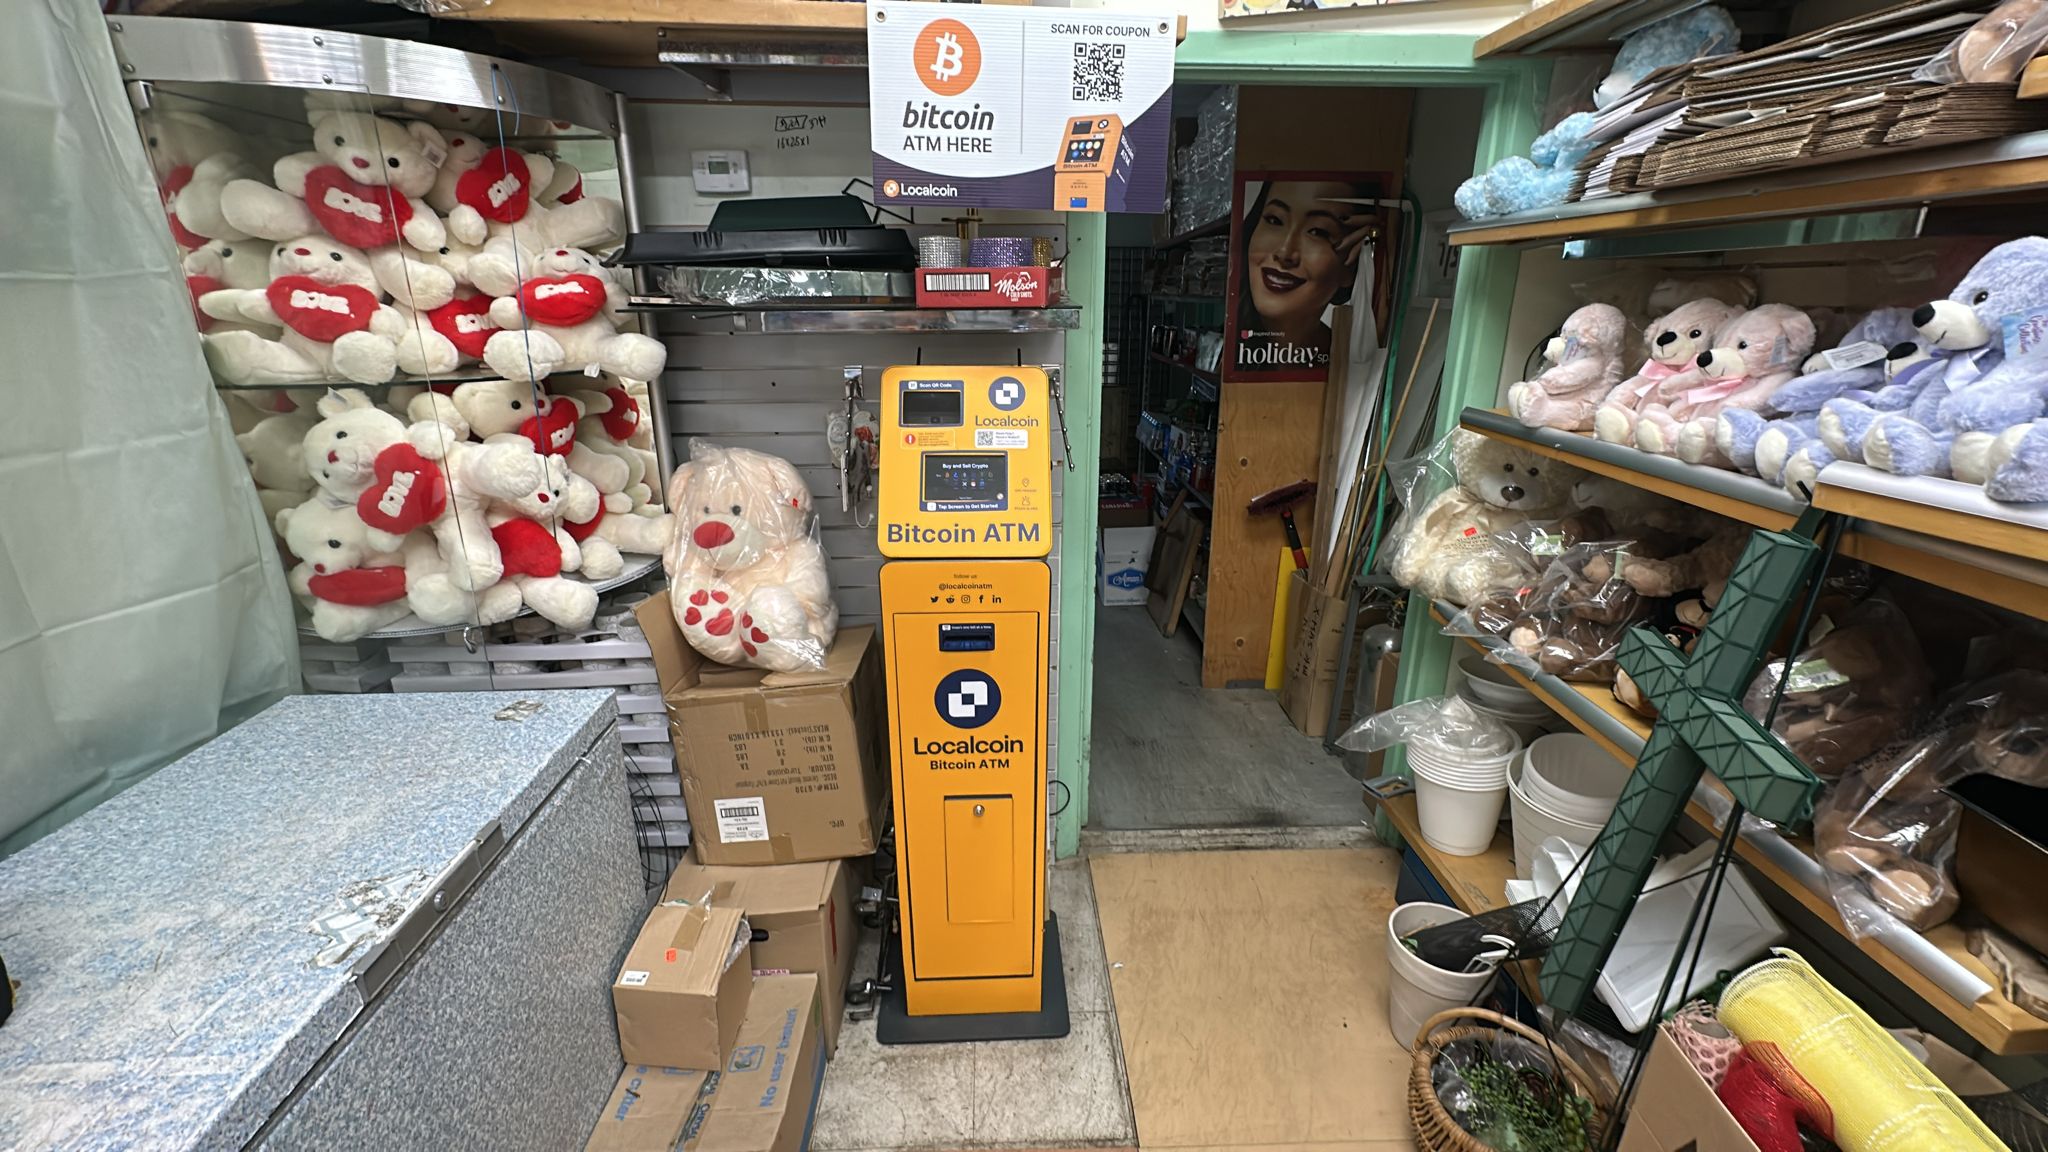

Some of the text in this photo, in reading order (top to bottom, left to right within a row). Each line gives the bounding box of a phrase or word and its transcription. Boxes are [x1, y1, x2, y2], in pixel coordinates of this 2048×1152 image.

[1051, 24, 1150, 38] SCAN FOR COUPON
[903, 101, 994, 131] bitcoin
[903, 136, 992, 153] ATM HERE
[901, 183, 958, 197] Localcoin
[994, 277, 1038, 297] Molson
[1238, 342, 1318, 367] holiday
[975, 415, 1039, 427] Localcoin
[888, 523, 1040, 543] Bitcoin ATM
[938, 582, 993, 591] @localcoinatm
[913, 735, 1024, 755] Localcoin
[930, 759, 1009, 770] Bitcoin ATM
